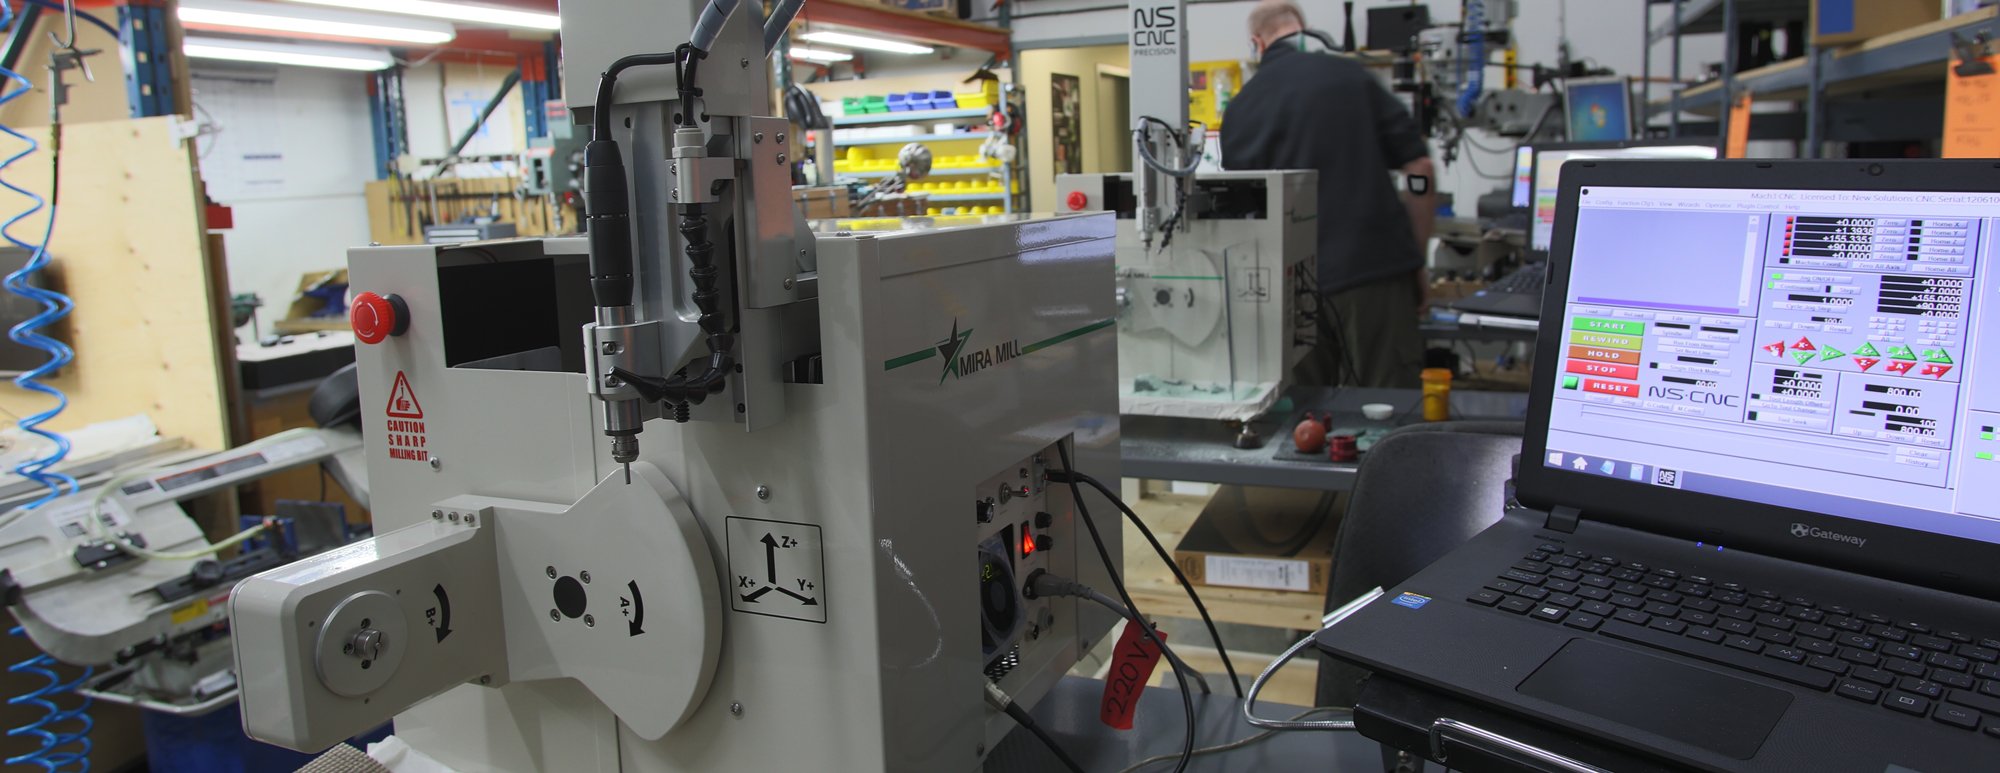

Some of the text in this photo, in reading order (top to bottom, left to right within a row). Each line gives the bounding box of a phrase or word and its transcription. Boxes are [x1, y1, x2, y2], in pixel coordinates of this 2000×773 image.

[1134, 6, 1175, 29] NS
[1134, 29, 1176, 46] CNC
[1134, 47, 1176, 56] PRECISION
[1873, 194, 1913, 202] Solutions
[1836, 218, 1875, 227] +0.0000
[1823, 235, 1873, 243] +155.3351
[1827, 243, 1872, 252] +90.0000
[1832, 252, 1871, 260] +0.0000
[1921, 279, 1964, 288] +0.0000
[1924, 287, 1963, 296] +7.0000
[1822, 297, 1854, 306] 1.0000
[1911, 294, 1962, 303] +155.0000
[1916, 303, 1961, 312] +90.0000
[1921, 311, 1960, 320] +0.0000
[1589, 321, 1626, 330] START
[1583, 335, 1630, 345] REWIND
[960, 339, 1021, 377] MIRA MILL
[1587, 350, 1620, 359] HOLD
[1586, 364, 1617, 374] STOP
[1593, 382, 1629, 392] RESET
[1782, 379, 1822, 390] +0.0000
[1781, 388, 1822, 399] +0.0000
[1887, 387, 1922, 398] 800.00
[1895, 405, 1920, 416] 0.00
[387, 420, 425, 433] CAUTION
[1920, 419, 1937, 428] 100
[1900, 426, 1936, 437] 800.00
[388, 434, 426, 447] SHARP
[389, 448, 428, 461] MILLING BIT
[1905, 458, 1928, 468] History
[1659, 470, 1674, 479] NS
[781, 536, 798, 548] Z+
[1810, 527, 1867, 548] Gateway
[738, 575, 756, 588] X+
[797, 578, 814, 591] Y+
